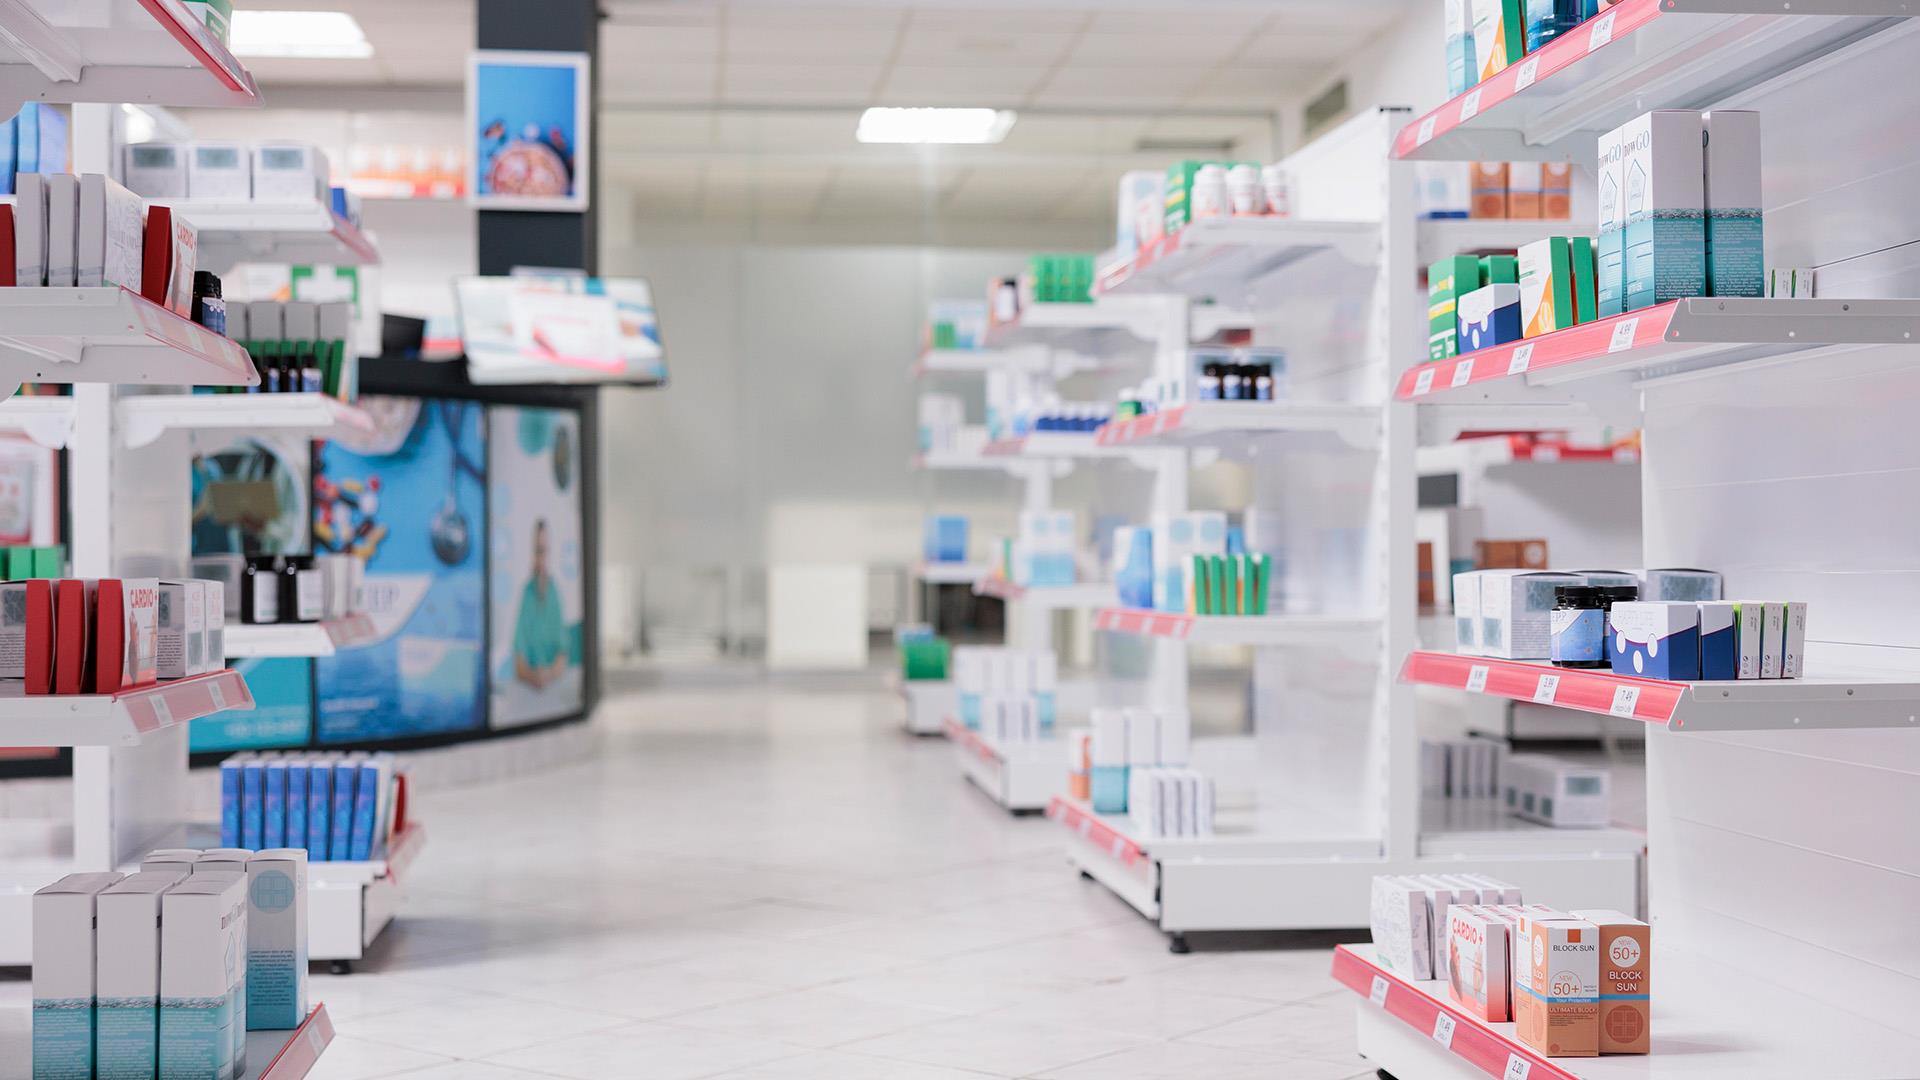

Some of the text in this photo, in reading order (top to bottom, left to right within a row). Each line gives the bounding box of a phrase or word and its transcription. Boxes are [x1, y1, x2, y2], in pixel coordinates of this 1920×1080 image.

[176, 222, 193, 250] CARDIO
[131, 588, 154, 608] CARDIO
[1452, 916, 1477, 945] CARDIO
[1552, 944, 1595, 952] BLOCK SUN
[1613, 947, 1639, 960] 50+
[1609, 971, 1642, 980] BLOCK
[1553, 982, 1580, 996] 50+
[1616, 982, 1637, 992] SUN
[1511, 1059, 1524, 1075] 2.20
